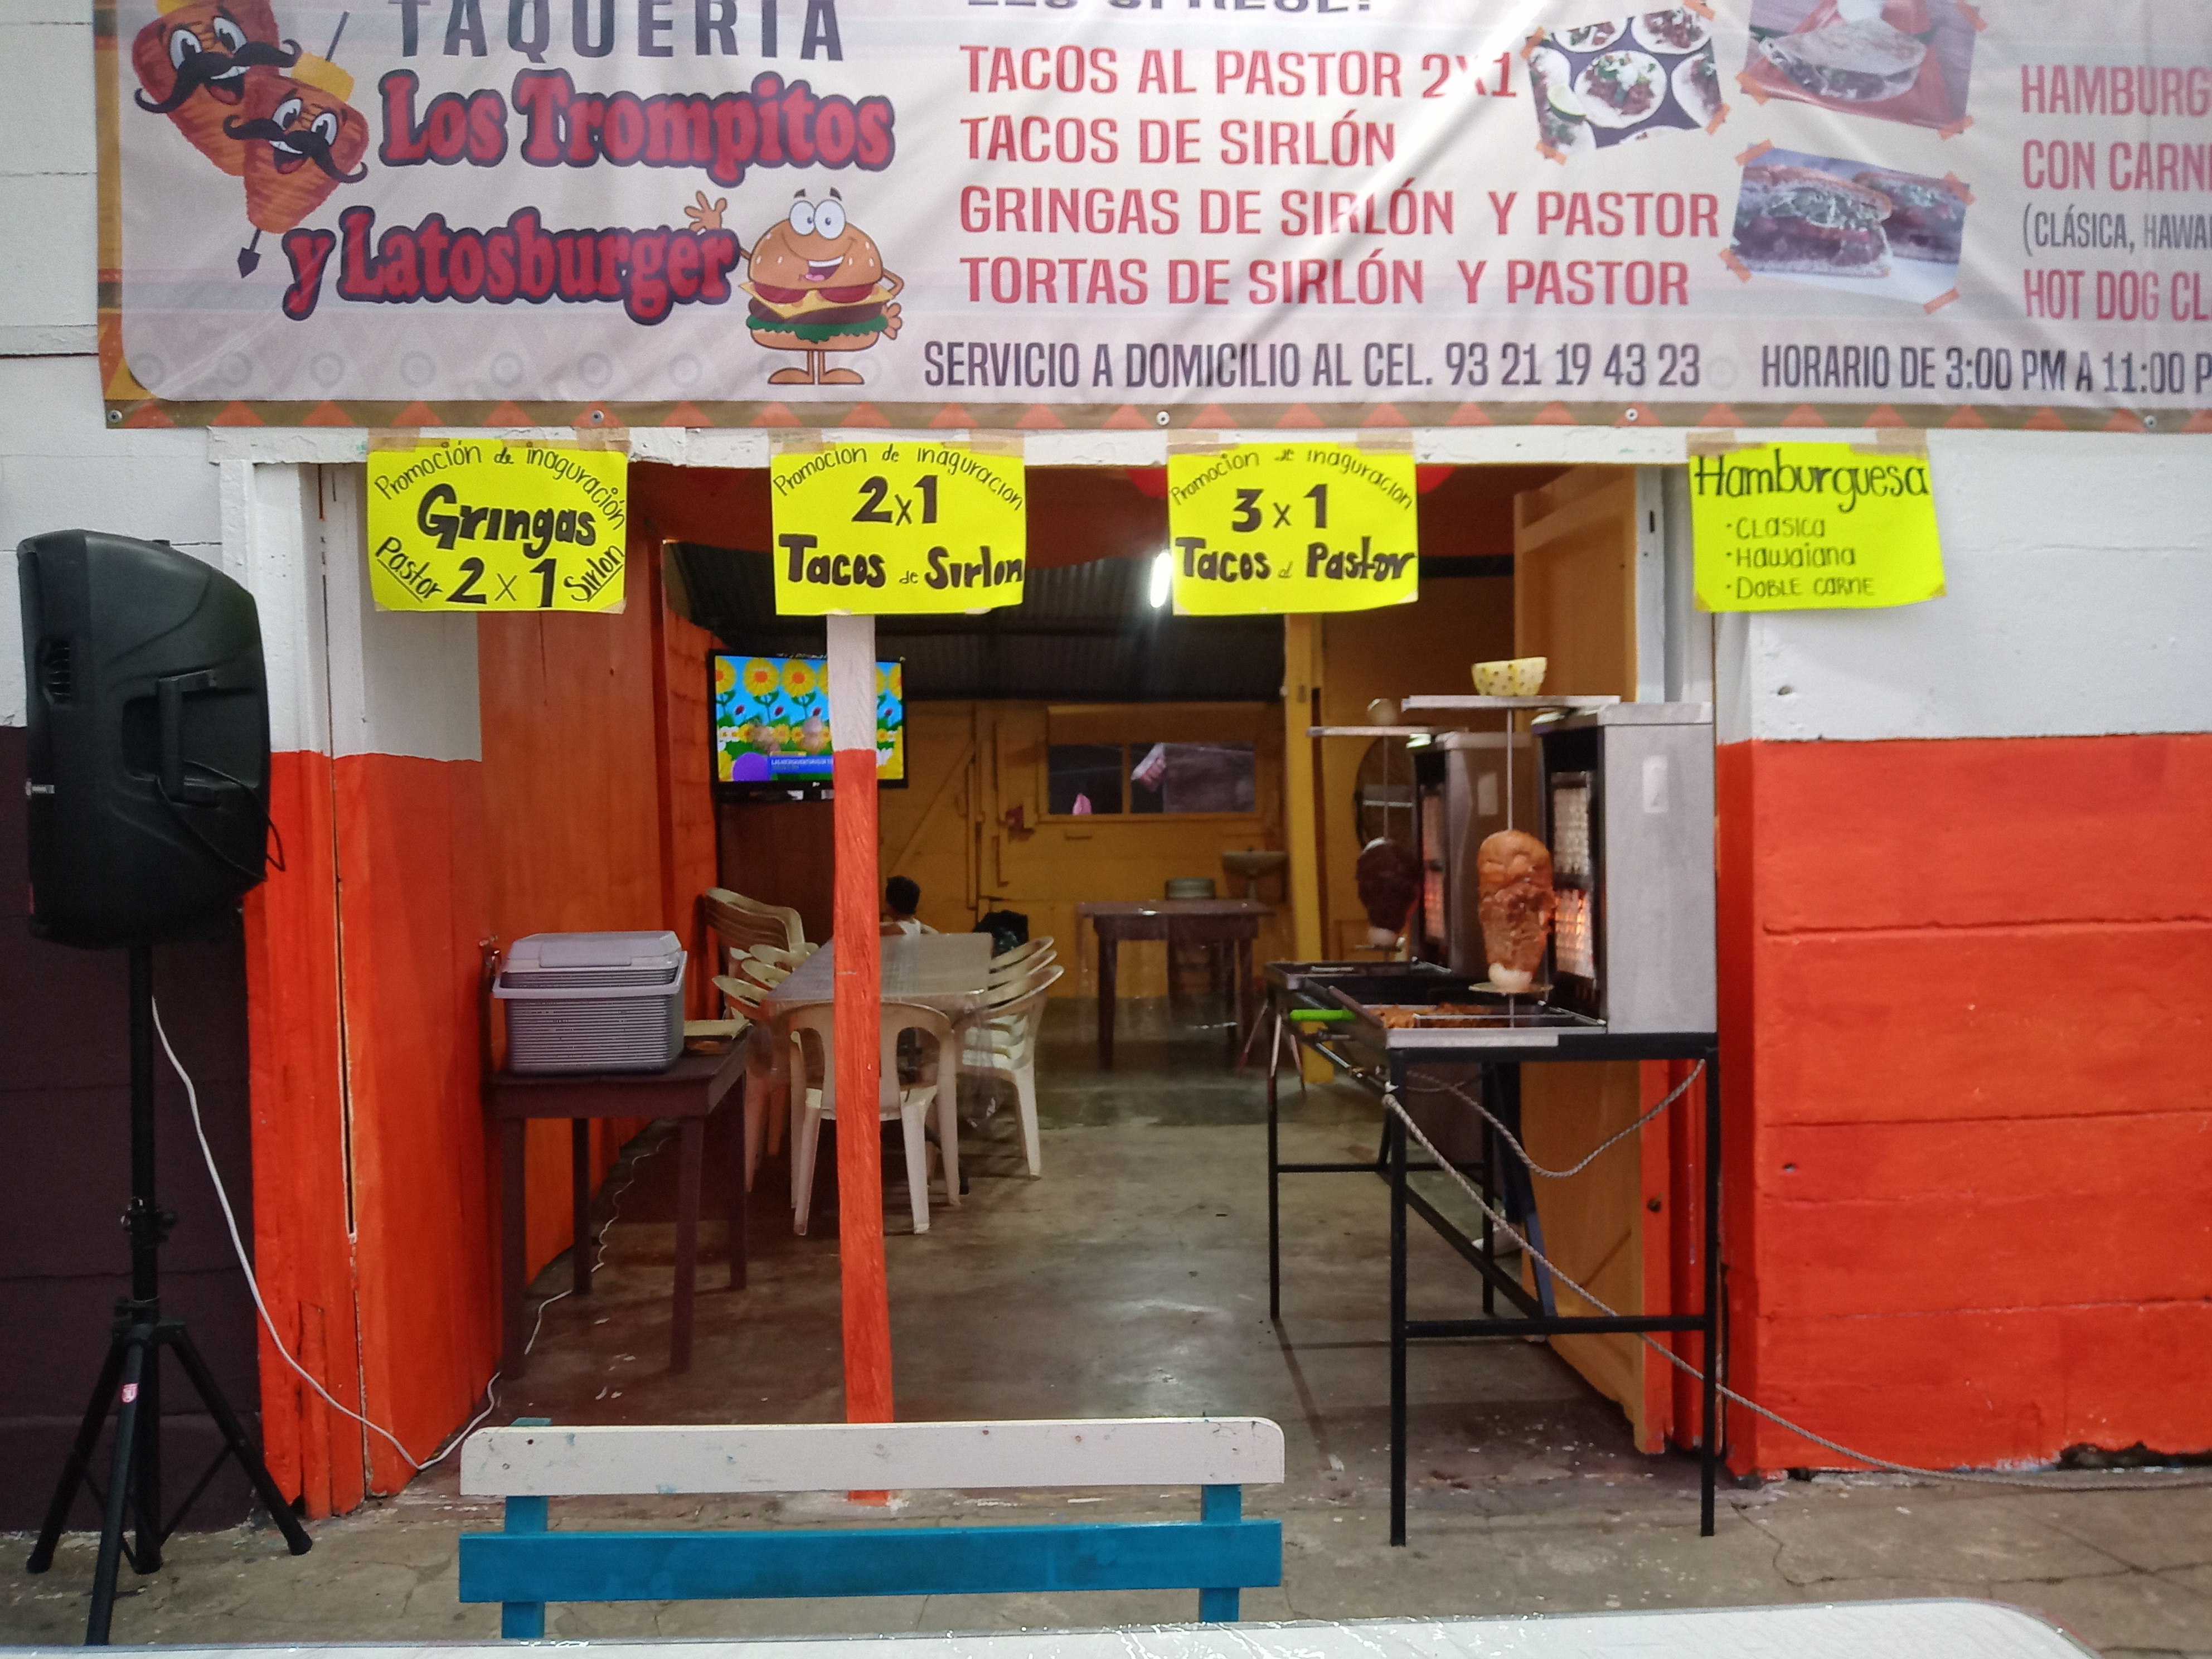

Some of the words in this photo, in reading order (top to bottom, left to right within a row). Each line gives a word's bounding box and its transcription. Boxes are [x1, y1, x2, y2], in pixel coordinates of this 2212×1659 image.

[960, 45, 1118, 93] TACOS
[1138, 50, 1197, 94] AL
[1216, 50, 1401, 97] PASTOR
[379, 69, 508, 167] Los
[512, 68, 895, 188] Trompitos
[960, 115, 1118, 163] TACOS
[1139, 119, 1201, 163] DE
[1221, 109, 1395, 166] SIRLÓN
[2023, 139, 2095, 190] CON
[960, 185, 1180, 235] GRINGAS
[1200, 190, 1261, 234] DE
[1281, 178, 1453, 236] SIRLÓN
[1488, 192, 1517, 235] Y
[1537, 191, 1719, 237] PASTOR
[2023, 202, 2135, 257] (CLÁSICA,
[282, 229, 336, 321] y
[337, 206, 740, 326] Latosburger
[960, 257, 1148, 305] TORTAS
[1169, 259, 1230, 305] DE
[1249, 249, 1424, 305] SIRLÓN
[1457, 260, 1487, 304] Y
[1507, 260, 1689, 305] PASTOR
[2024, 269, 2085, 320] HOT
[2096, 270, 2160, 321] DOG
[924, 341, 1080, 387] SERVICIO
[1093, 344, 1113, 387] A
[1126, 343, 1300, 388] DOMICILIO
[1313, 343, 1352, 386] AL
[1364, 342, 1432, 387] CEL.
[1446, 342, 1488, 387] 93
[1501, 343, 1542, 386] 21
[1556, 343, 1591, 386] 19
[1604, 343, 1646, 387] 43
[1658, 343, 1700, 387] 23
[1762, 345, 1890, 389] HORARIO
[1900, 347, 1935, 389] DE
[1946, 347, 2012, 390] 3:00
[2022, 348, 2067, 391] PM
[2075, 351, 2093, 391] A
[2102, 351, 2185, 394] 11:00
[882, 444, 900, 462] de
[1695, 447, 1931, 513] Hamburguesa
[375, 440, 482, 500] Promoción
[494, 446, 515, 464] de
[527, 442, 625, 530] inaguración
[418, 483, 596, 559] Gringas
[375, 536, 444, 600] Pastor
[778, 533, 885, 588] Tacos
[899, 570, 919, 584] de
[925, 545, 1023, 590] Sirlon
[1175, 537, 1271, 582] Tacos
[1306, 536, 1417, 582] Pastor
